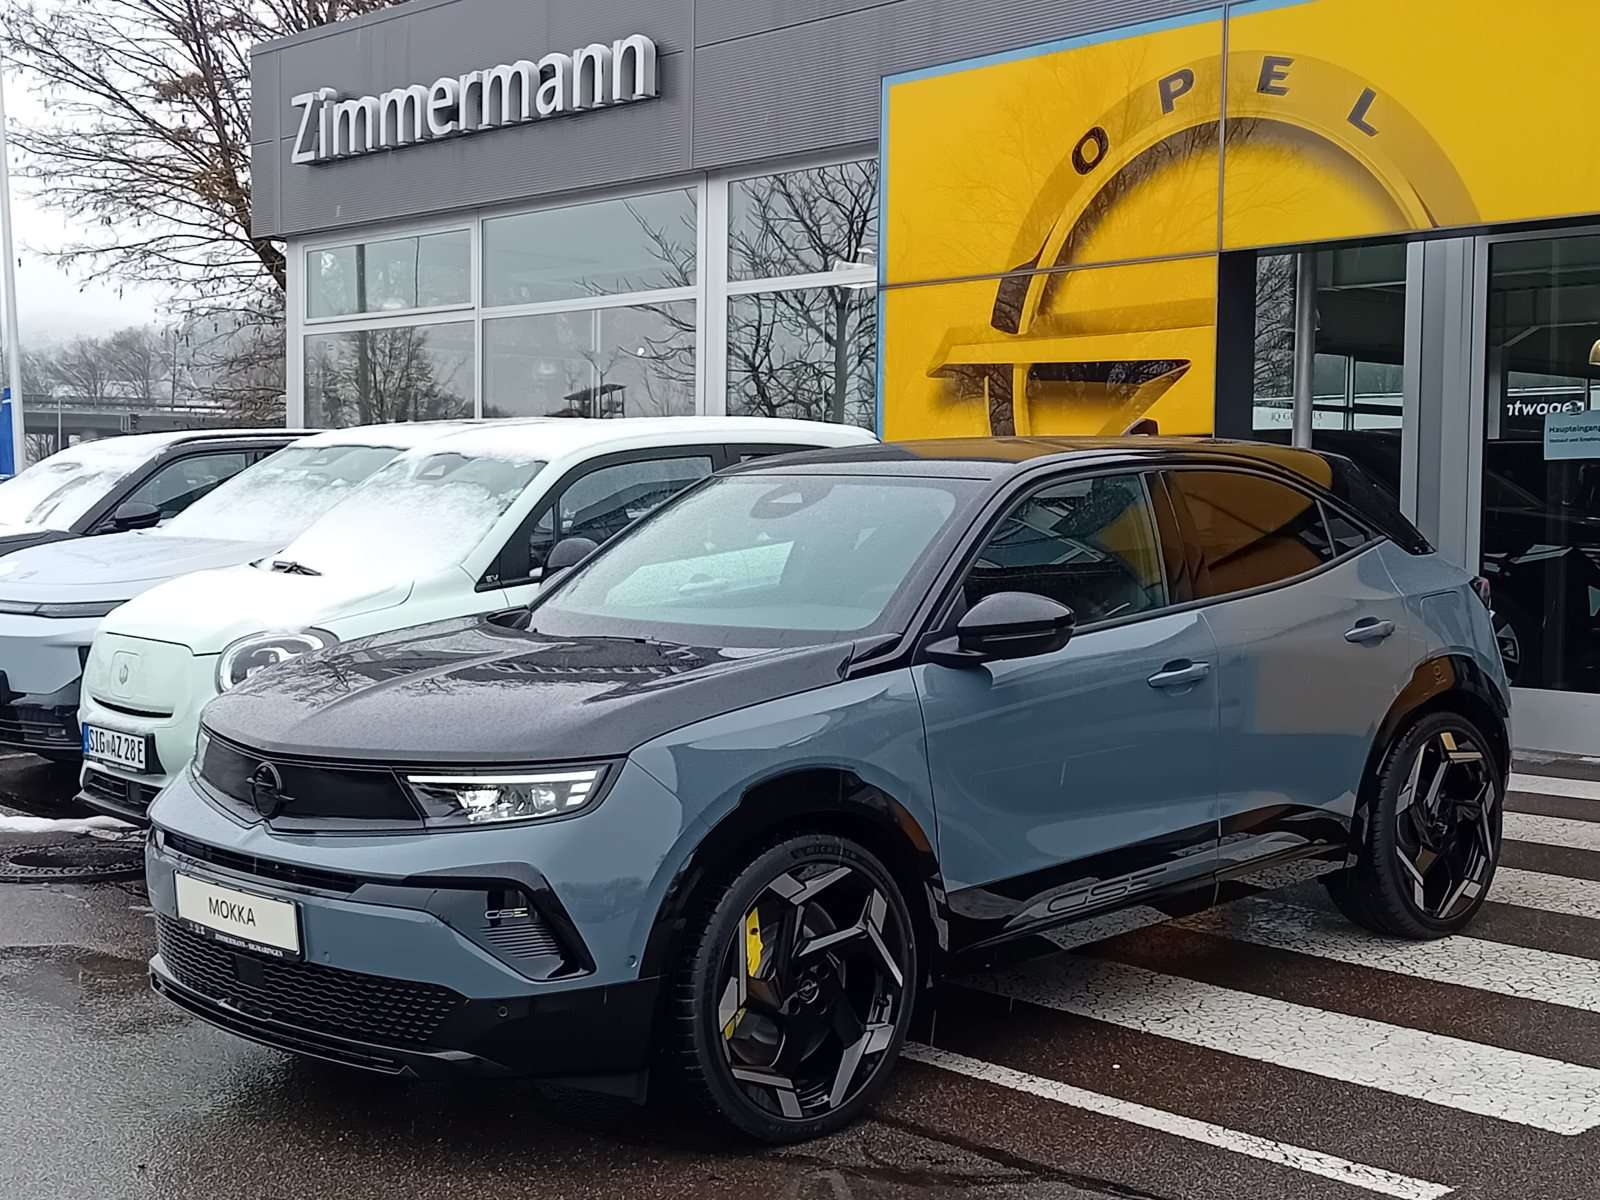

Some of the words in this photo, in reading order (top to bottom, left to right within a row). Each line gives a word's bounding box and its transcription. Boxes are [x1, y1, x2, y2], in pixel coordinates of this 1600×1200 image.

[290, 33, 660, 164] Zimmermann
[1071, 55, 1379, 176] OPEL
[89, 729, 105, 753] SIG
[111, 734, 122, 758] AZ
[208, 896, 256, 927] MOKKA
[484, 907, 528, 919] GSE
